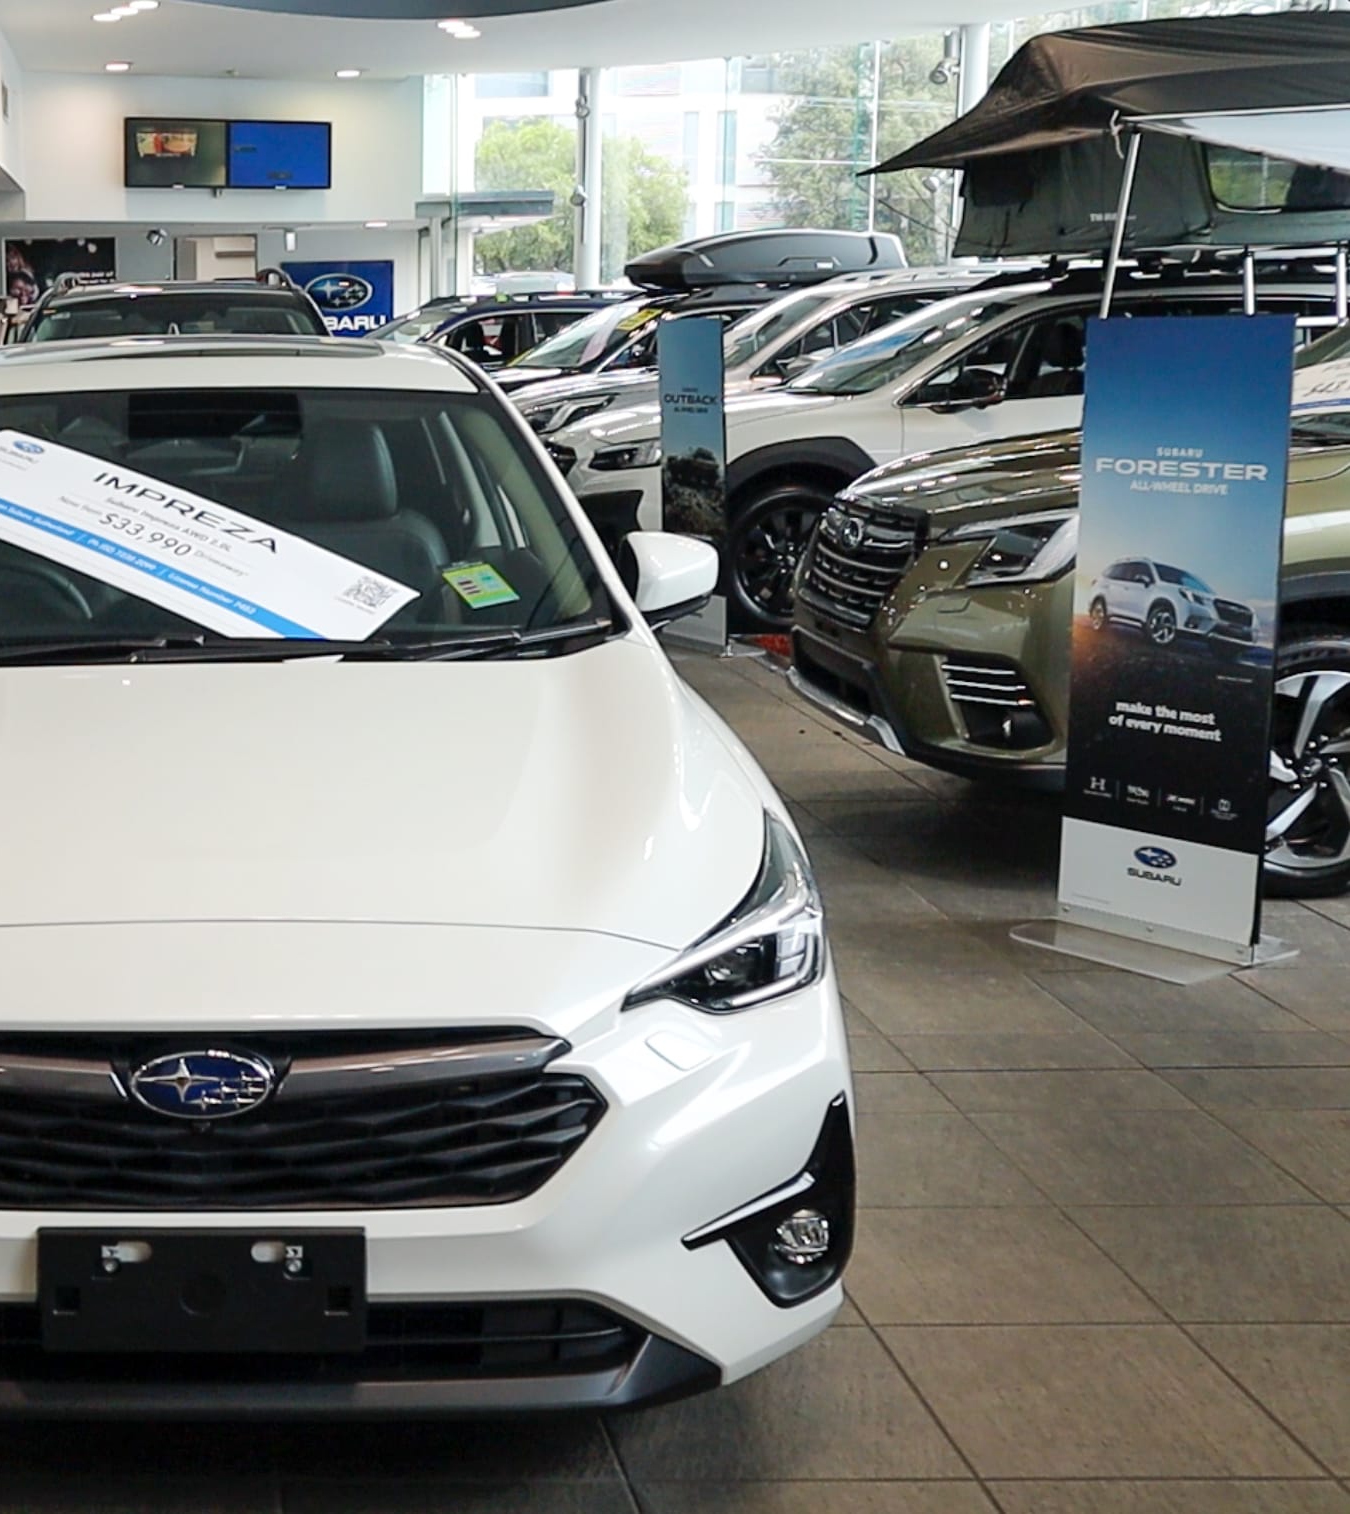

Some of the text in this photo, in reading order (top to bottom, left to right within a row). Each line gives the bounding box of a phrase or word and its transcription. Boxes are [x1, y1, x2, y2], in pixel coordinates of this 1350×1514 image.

[324, 314, 386, 331] BARU
[664, 393, 718, 405] OUTBACK
[1156, 447, 1203, 459] SUBARU
[1095, 457, 1269, 481] FORESTER
[1130, 480, 1229, 496] ALL-WHEEL DRIVE
[93, 472, 278, 554] IMPREZA
[99, 511, 192, 557] $33,990
[1116, 701, 1216, 725] make the most
[1108, 714, 1222, 742] of every moment
[1127, 867, 1182, 886] SUBARU
